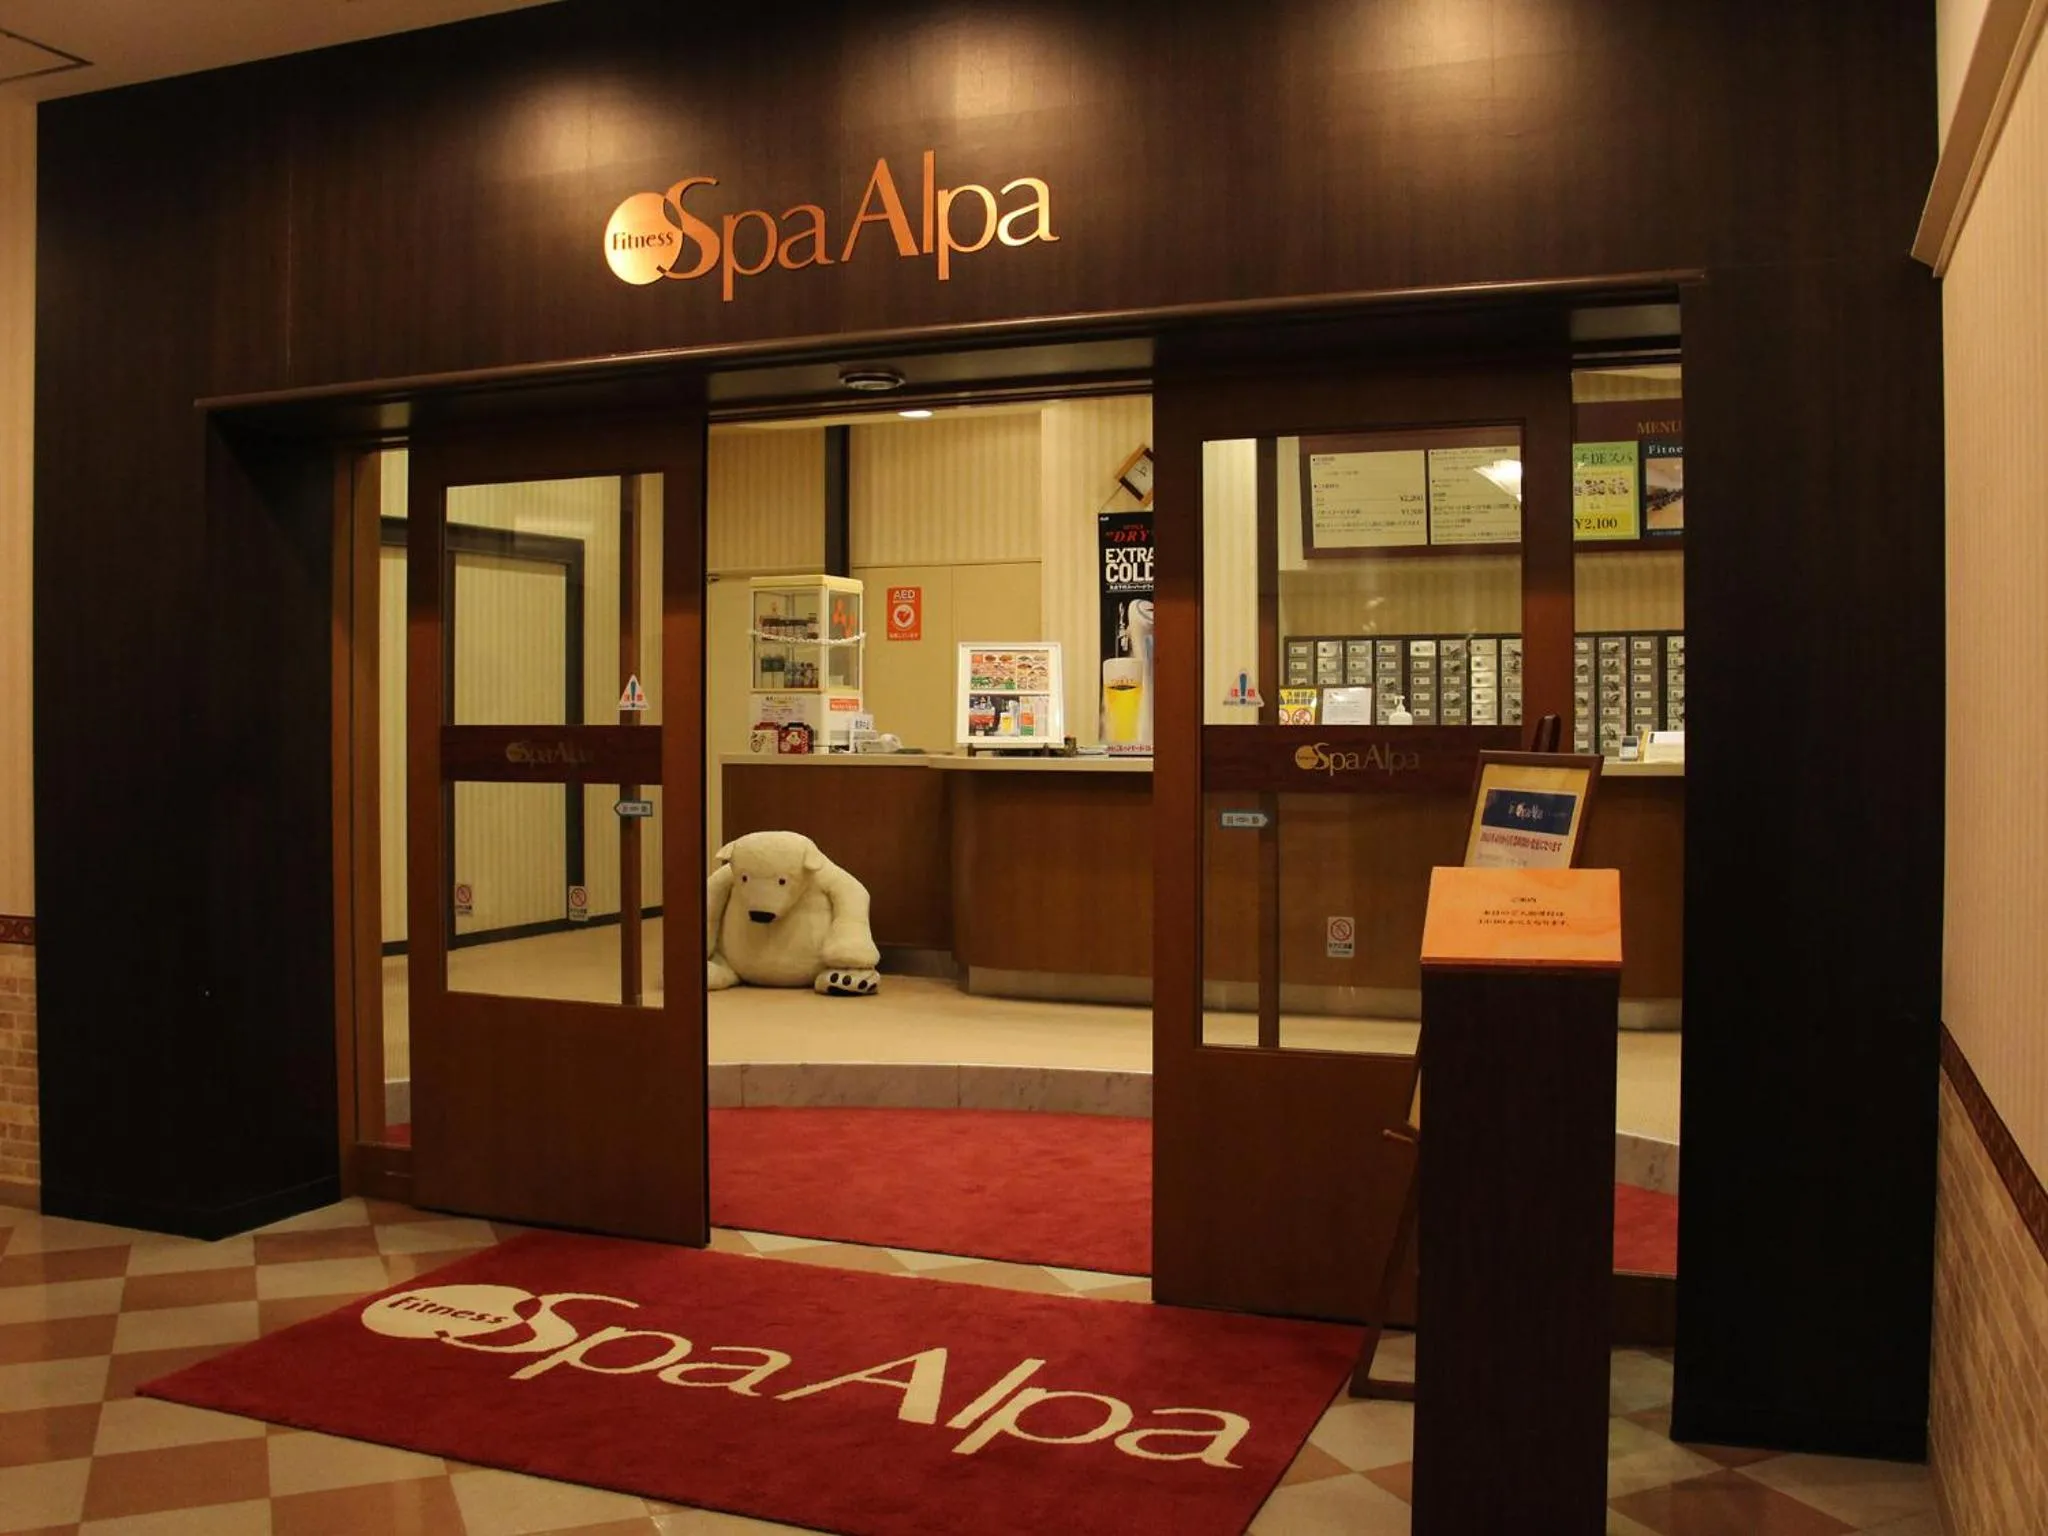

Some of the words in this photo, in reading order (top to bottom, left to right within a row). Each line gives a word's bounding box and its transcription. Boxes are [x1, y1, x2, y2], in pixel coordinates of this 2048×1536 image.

[612, 229, 674, 252] Fitness
[656, 176, 835, 302] Spa
[841, 149, 1060, 280] Alpa
[1105, 547, 1154, 563] EXTRA
[894, 589, 915, 600] AED
[1314, 742, 1360, 776] Spa
[1363, 742, 1420, 777] Alpa
[387, 1296, 508, 1325] Fitness
[434, 1292, 792, 1397] Spa
[774, 1347, 1251, 1469] Alpa
